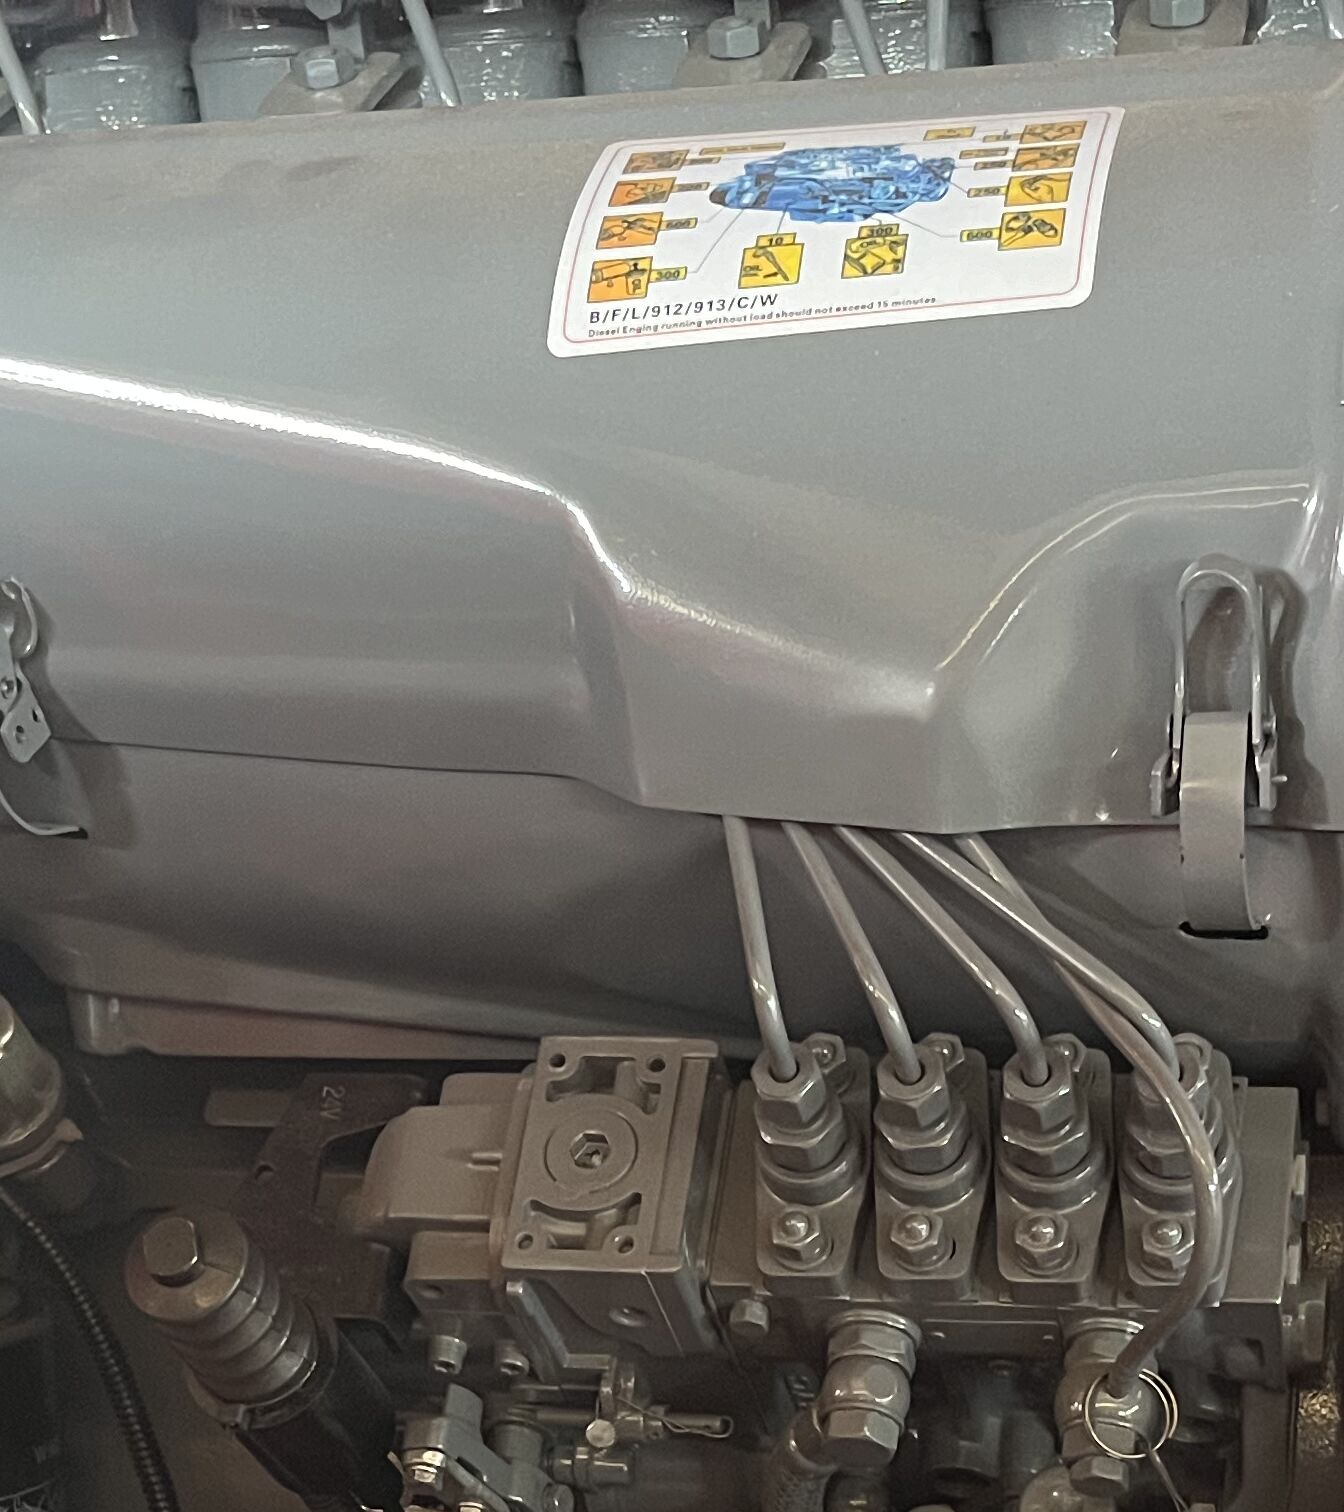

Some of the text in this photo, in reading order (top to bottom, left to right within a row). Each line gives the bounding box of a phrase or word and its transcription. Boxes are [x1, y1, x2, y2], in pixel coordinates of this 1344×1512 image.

[767, 237, 784, 246] 10
[589, 294, 778, 323] B/F/L/912/913/C/W
[705, 314, 747, 326] without
[748, 311, 773, 322] load
[775, 308, 812, 319] should
[814, 306, 833, 315] not
[835, 302, 874, 313] exceed
[877, 300, 889, 309] 15
[891, 297, 937, 308] minutes
